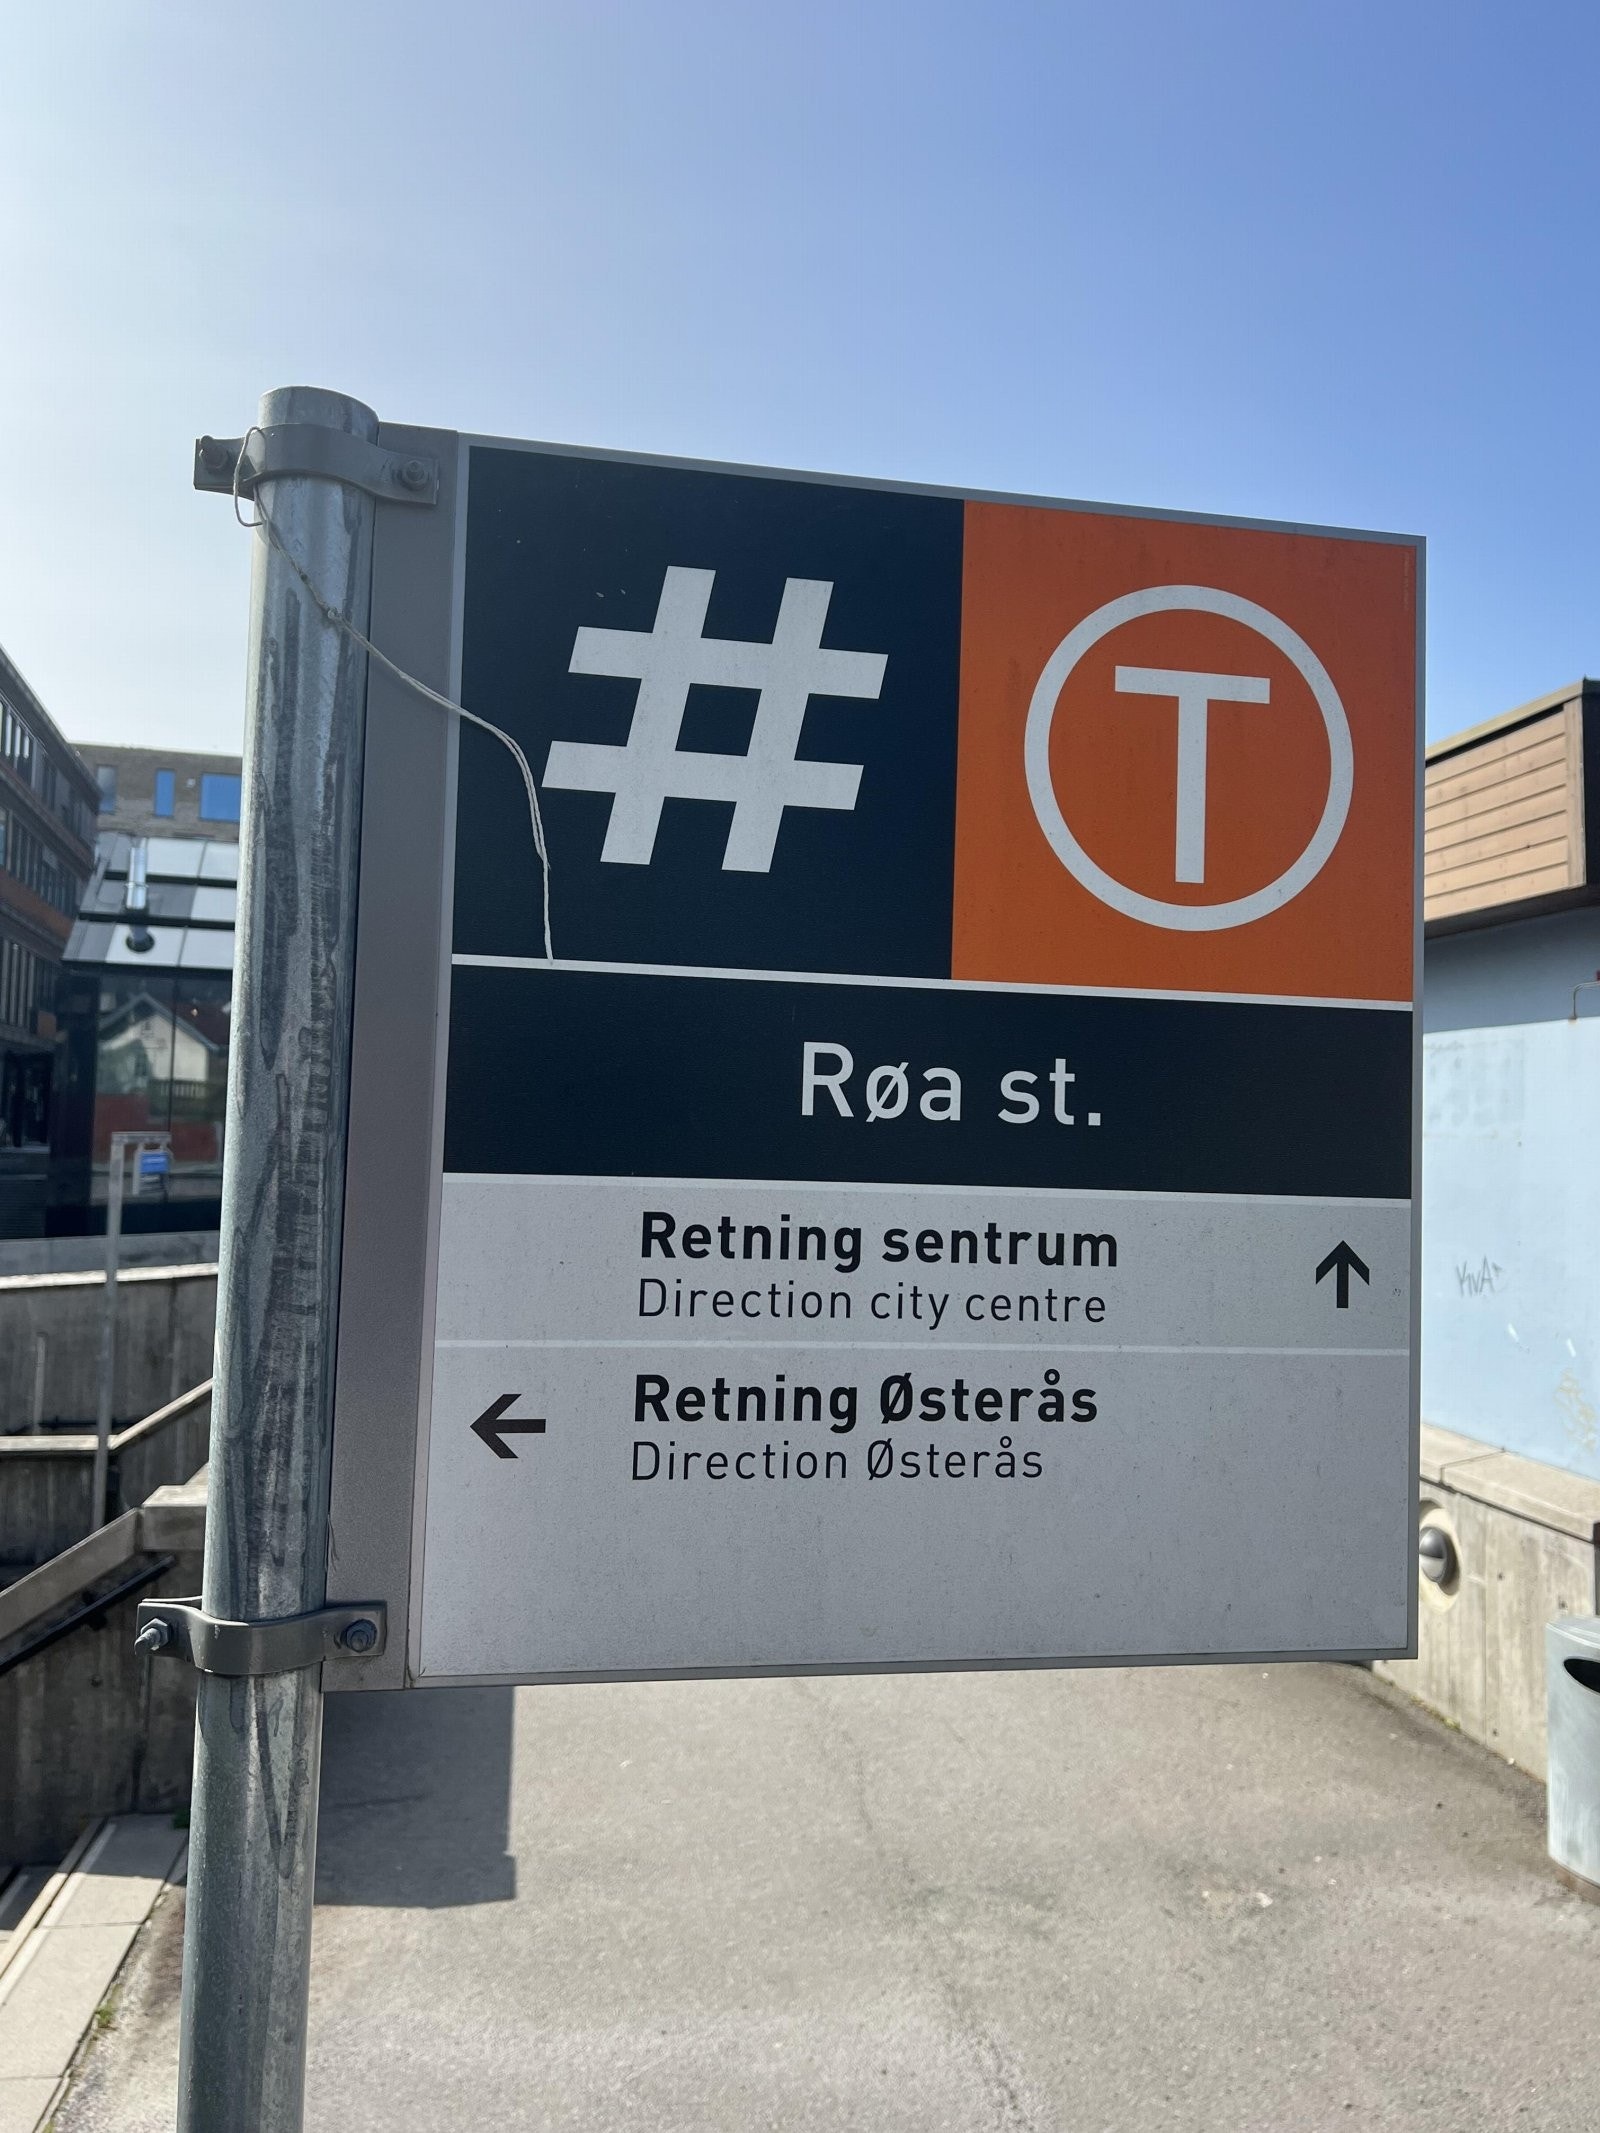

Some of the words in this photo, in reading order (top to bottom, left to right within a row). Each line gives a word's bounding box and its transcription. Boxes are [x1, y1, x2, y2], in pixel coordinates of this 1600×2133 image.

[1113, 664, 1271, 885] T
[801, 1041, 962, 1123] Røa
[997, 1058, 1101, 1126] st.
[641, 1211, 862, 1274] Retning
[881, 1222, 1118, 1268] sentrum
[638, 1278, 851, 1319] Direction
[870, 1285, 950, 1331] city
[965, 1288, 1106, 1323] centre
[634, 1374, 858, 1434] Retning
[880, 1368, 1098, 1425] Østerås
[632, 1441, 847, 1481] Direction
[867, 1435, 1043, 1481] Østerås
